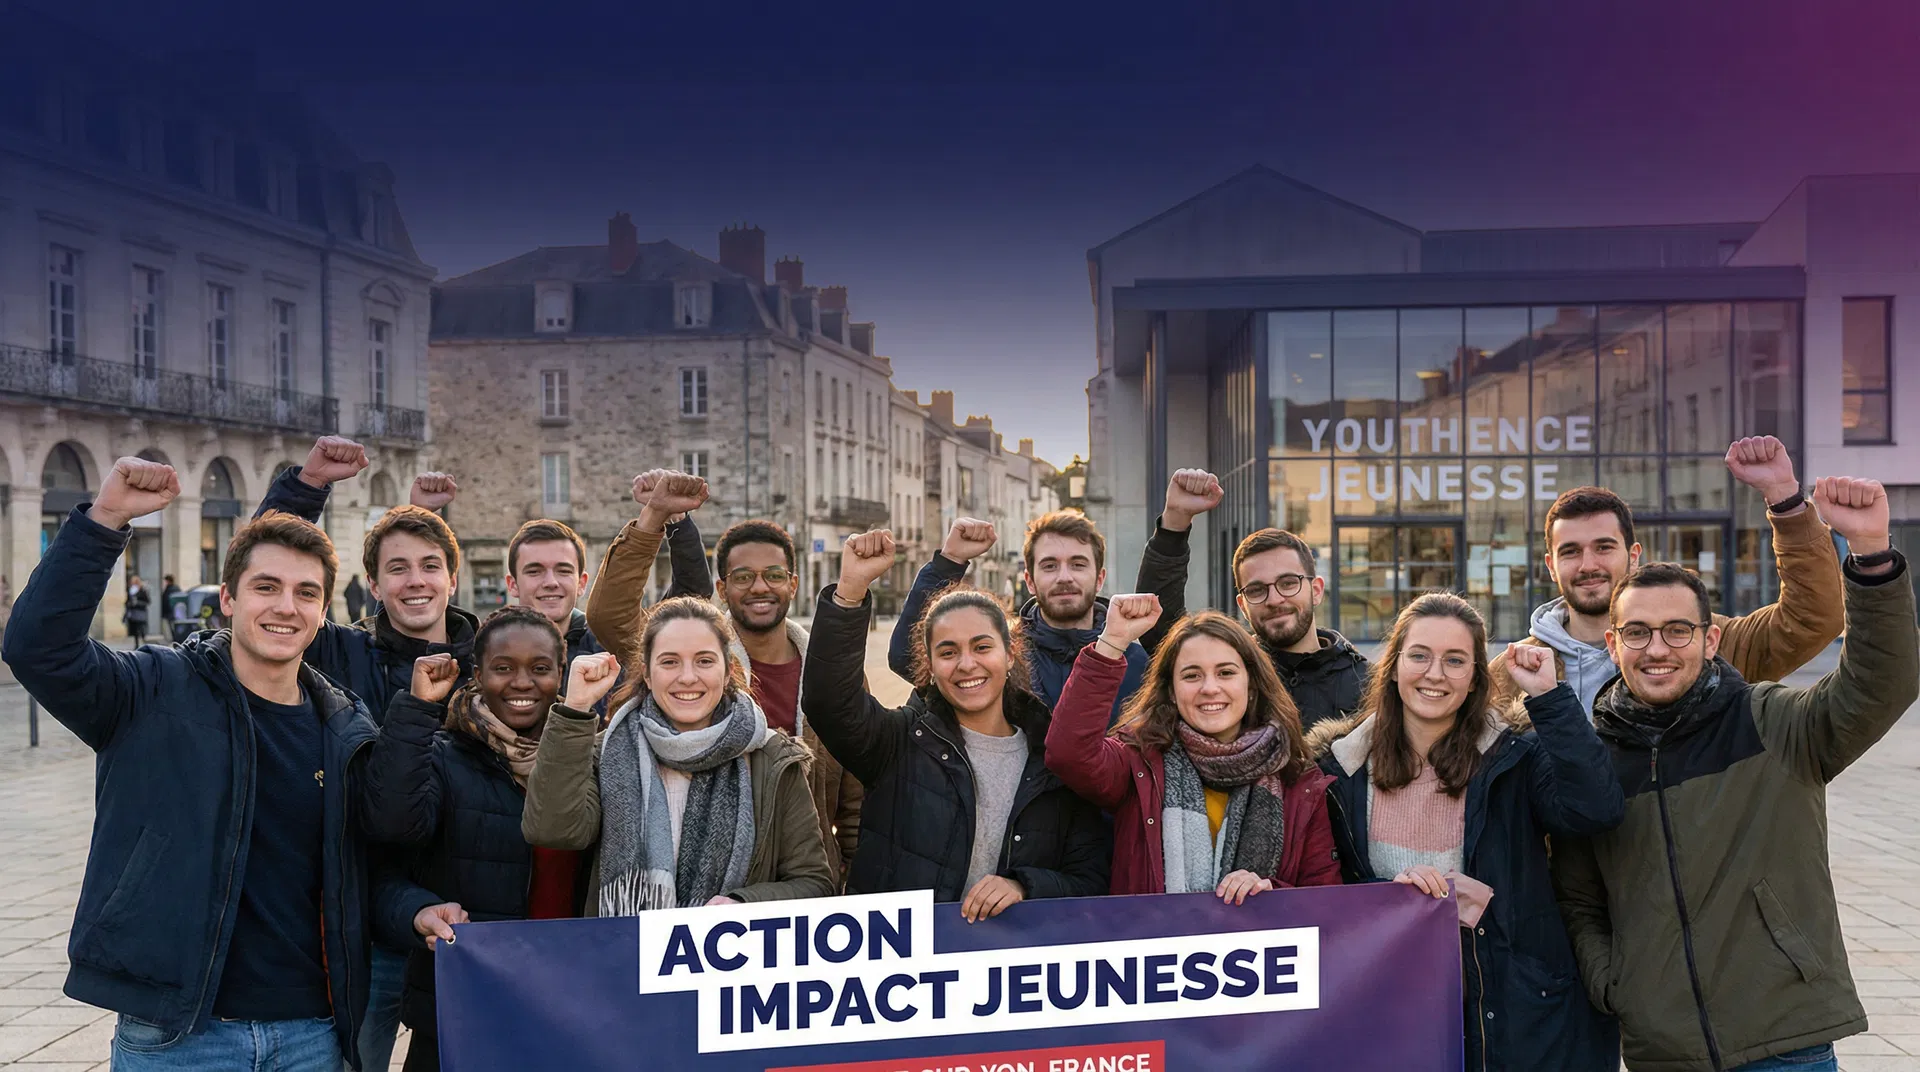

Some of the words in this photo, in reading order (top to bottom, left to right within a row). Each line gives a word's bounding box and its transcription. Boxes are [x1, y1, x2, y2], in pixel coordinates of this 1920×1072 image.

[1301, 416, 1592, 452] YOUTHENCE
[1308, 464, 1559, 501] JEUNESSE
[658, 908, 912, 976] ACTION
[720, 970, 960, 1034] IMPACT
[972, 946, 1298, 1016] JEUNESSE
[1049, 1053, 1150, 1072] FRANCE
